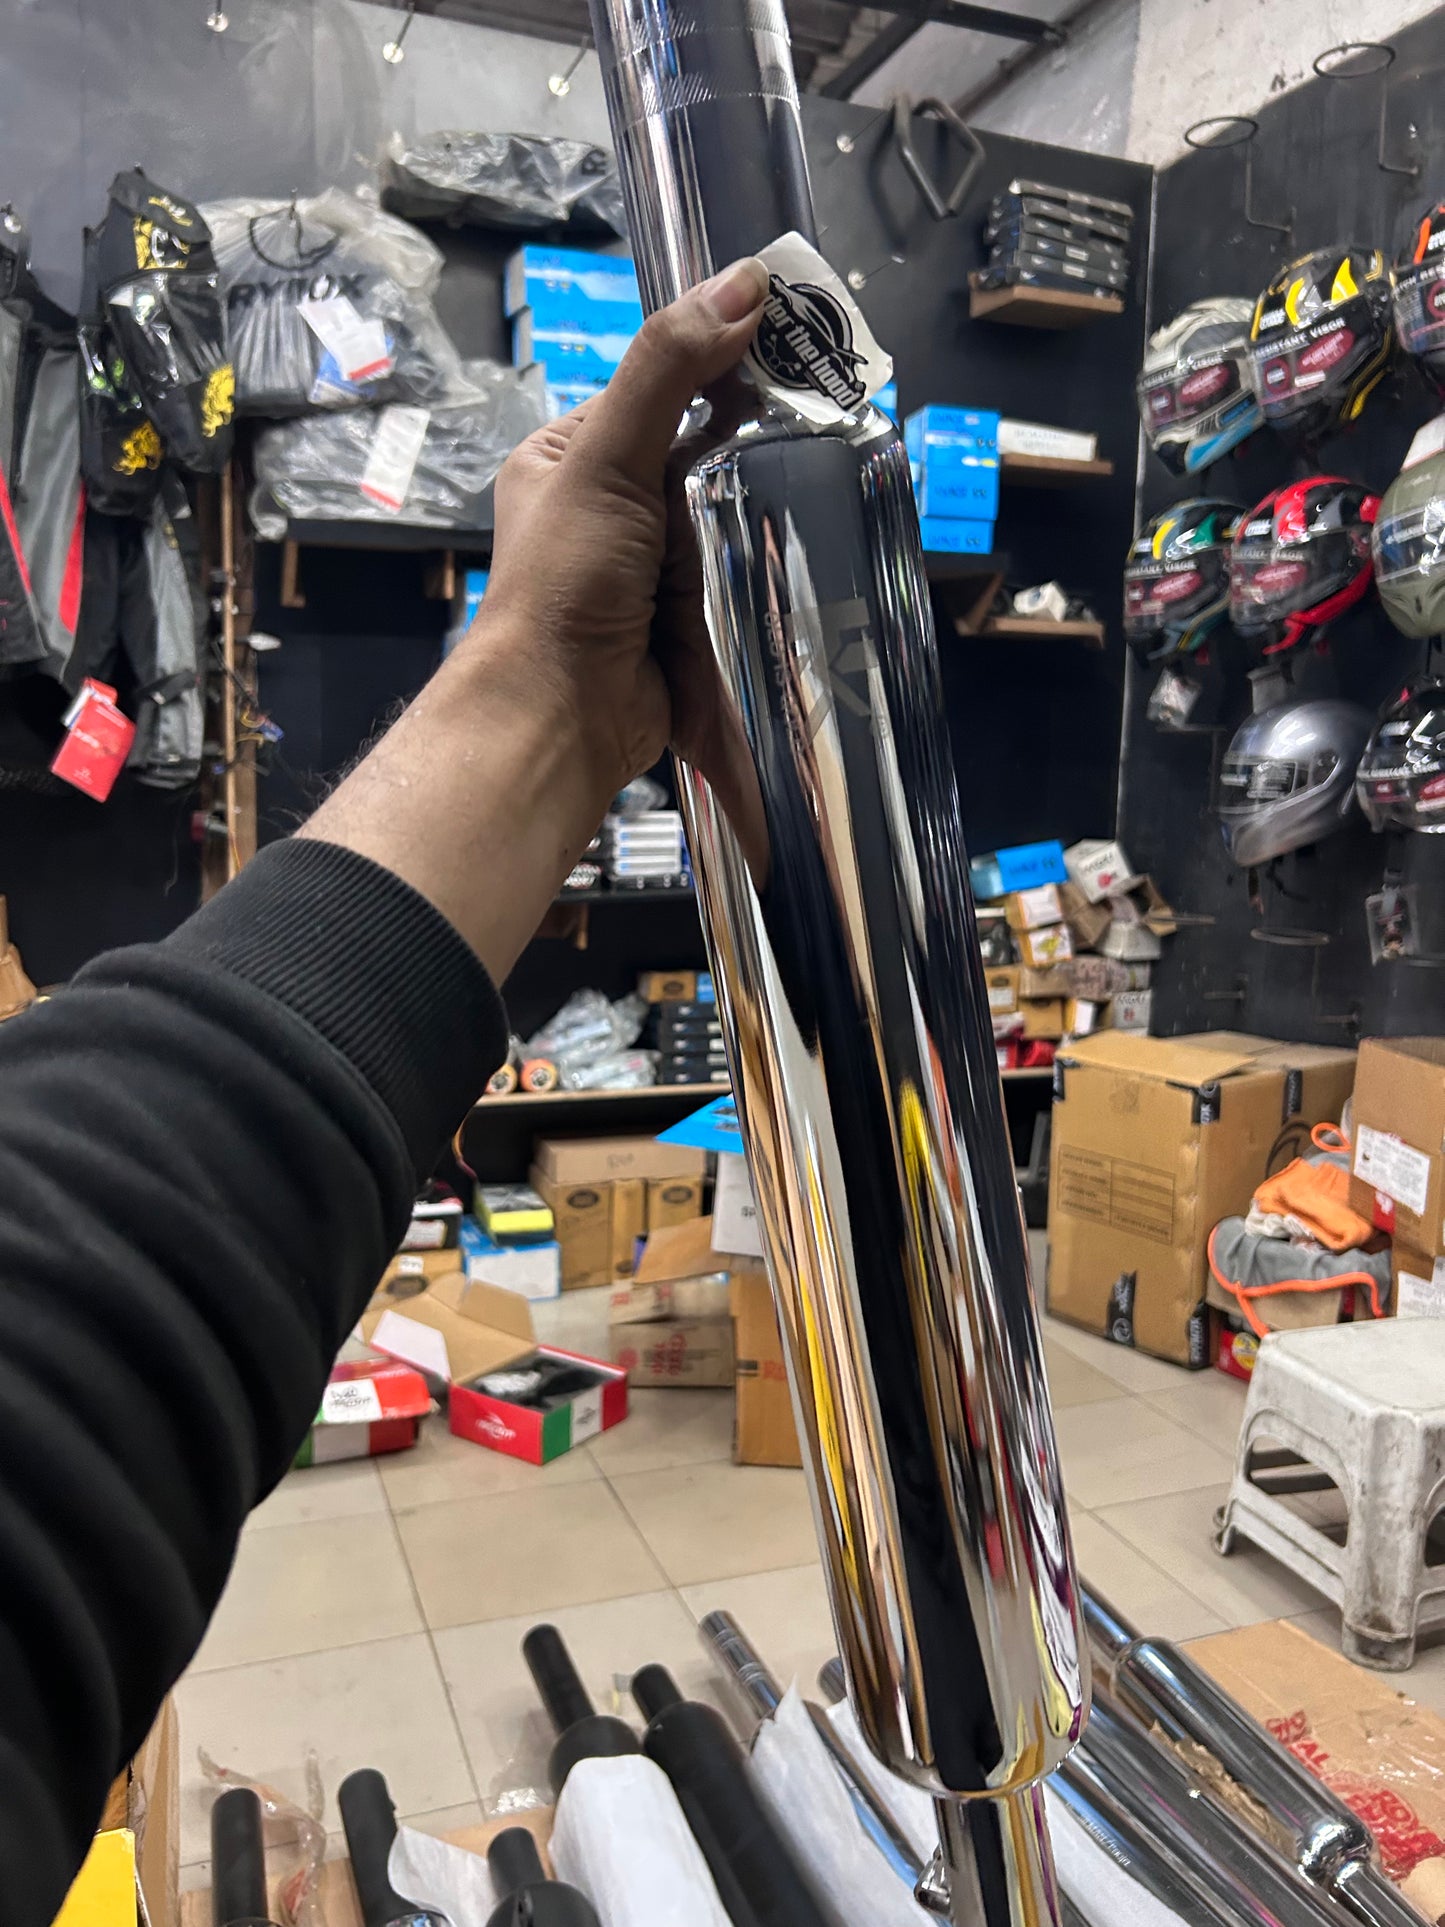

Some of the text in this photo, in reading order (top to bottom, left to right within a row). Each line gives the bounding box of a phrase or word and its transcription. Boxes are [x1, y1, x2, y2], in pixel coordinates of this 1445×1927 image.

[763, 294, 861, 409] der the hood
[1309, 317, 1346, 338] VISOR
